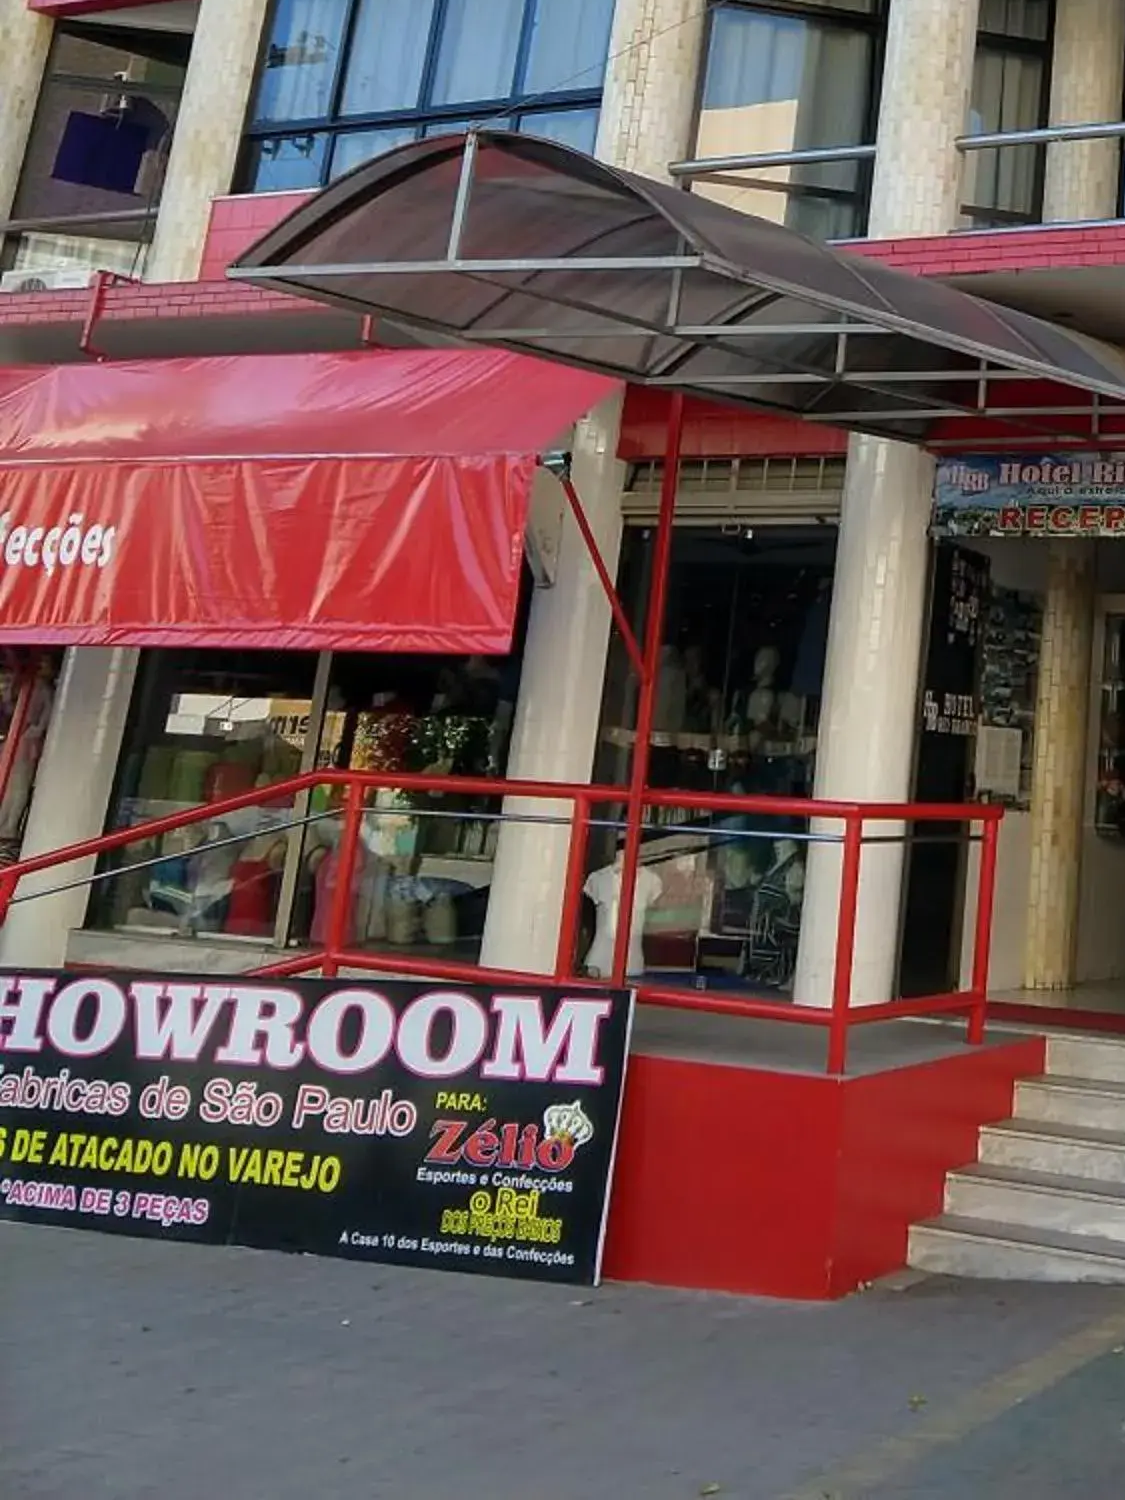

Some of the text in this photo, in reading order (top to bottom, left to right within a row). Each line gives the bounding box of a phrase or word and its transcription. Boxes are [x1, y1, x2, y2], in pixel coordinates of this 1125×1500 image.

[999, 461, 1082, 485] Hotel
[0, 1065, 418, 1137] abricas de São Paulo
[436, 1091, 488, 1112] PARA:
[10, 1129, 48, 1164] DE
[48, 1132, 174, 1176] ATACADO
[177, 1144, 220, 1182] NO
[229, 1147, 342, 1194] VAREJO
[424, 1118, 577, 1173] Zélio
[416, 1167, 574, 1194] Esportes e Confecções
[80, 1188, 112, 1215] DE
[113, 1191, 132, 1216] 3
[132, 1196, 209, 1227] PEÇAS
[495, 1187, 541, 1219] Rei
[338, 1230, 349, 1245] A
[351, 1232, 379, 1248] Casa
[397, 1236, 418, 1251] dos
[421, 1237, 470, 1256] Esportes
[472, 1245, 480, 1256] e
[483, 1244, 503, 1258] das
